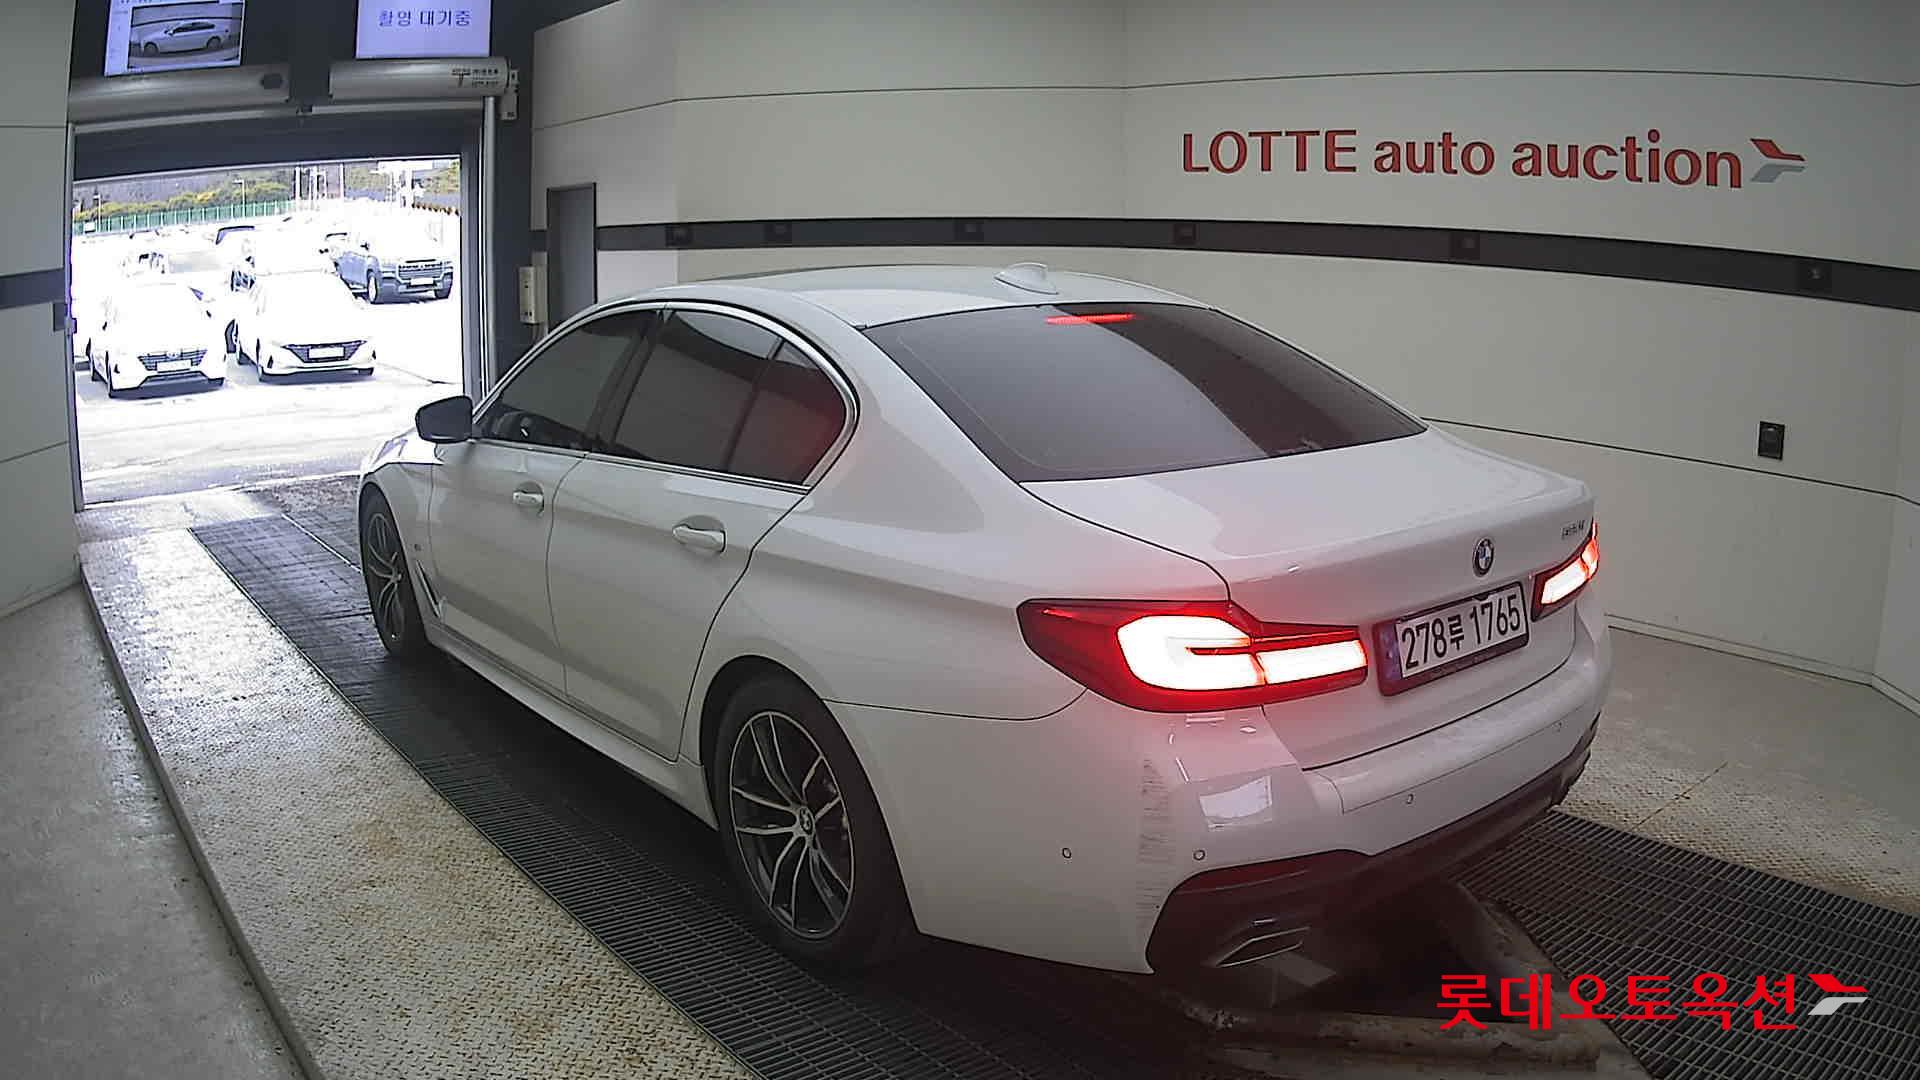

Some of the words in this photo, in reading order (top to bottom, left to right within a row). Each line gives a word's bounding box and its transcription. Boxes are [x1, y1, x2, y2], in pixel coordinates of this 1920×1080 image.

[420, 9, 471, 27] 대기중
[1183, 130, 1357, 172] LOTTE
[1375, 131, 1495, 174] auto
[1511, 129, 1742, 188] auction
